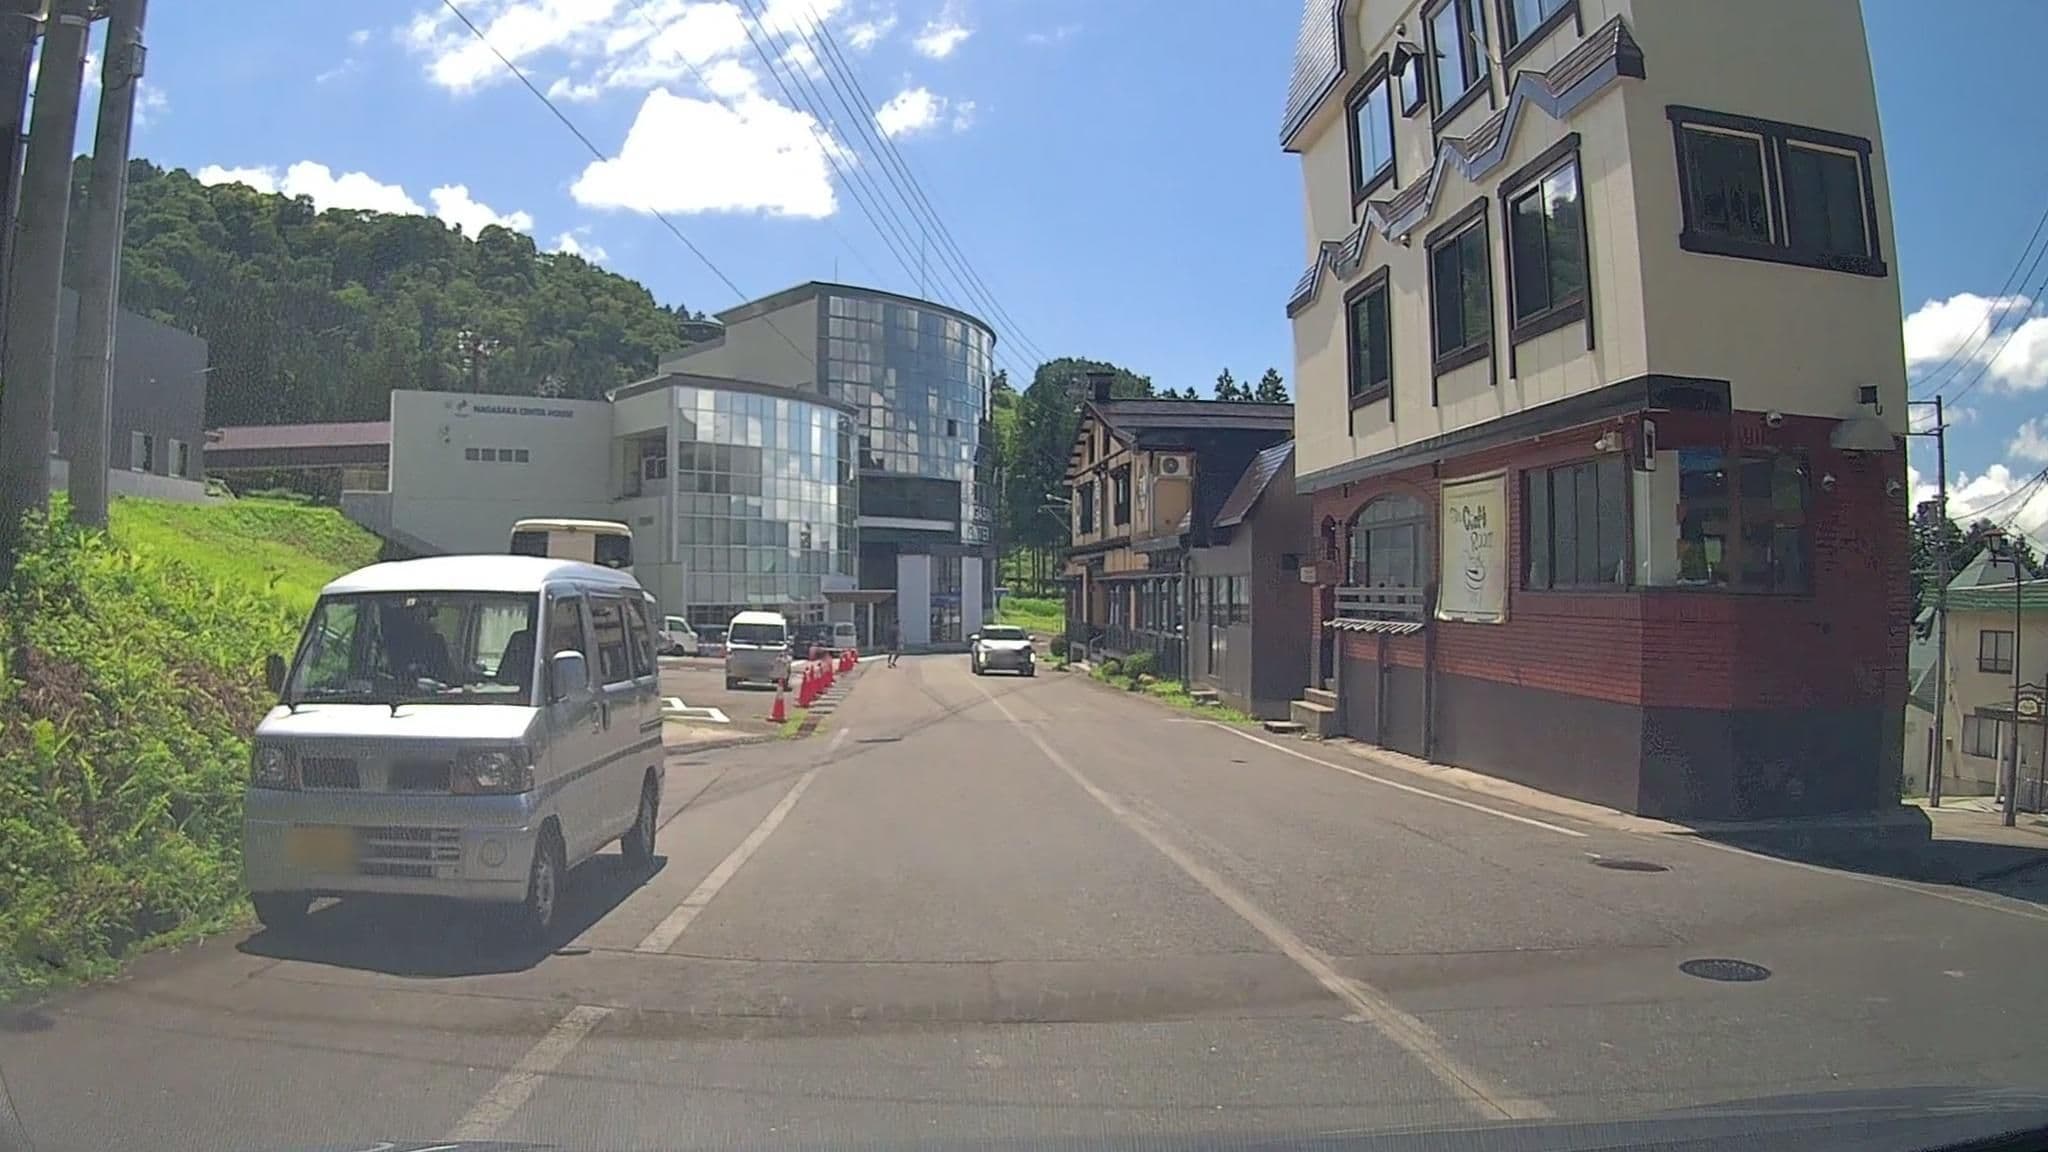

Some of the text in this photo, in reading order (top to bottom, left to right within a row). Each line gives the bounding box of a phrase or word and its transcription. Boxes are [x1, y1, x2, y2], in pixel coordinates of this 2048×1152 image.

[473, 405, 574, 418] NAGASAKA CENTER HOUSE
